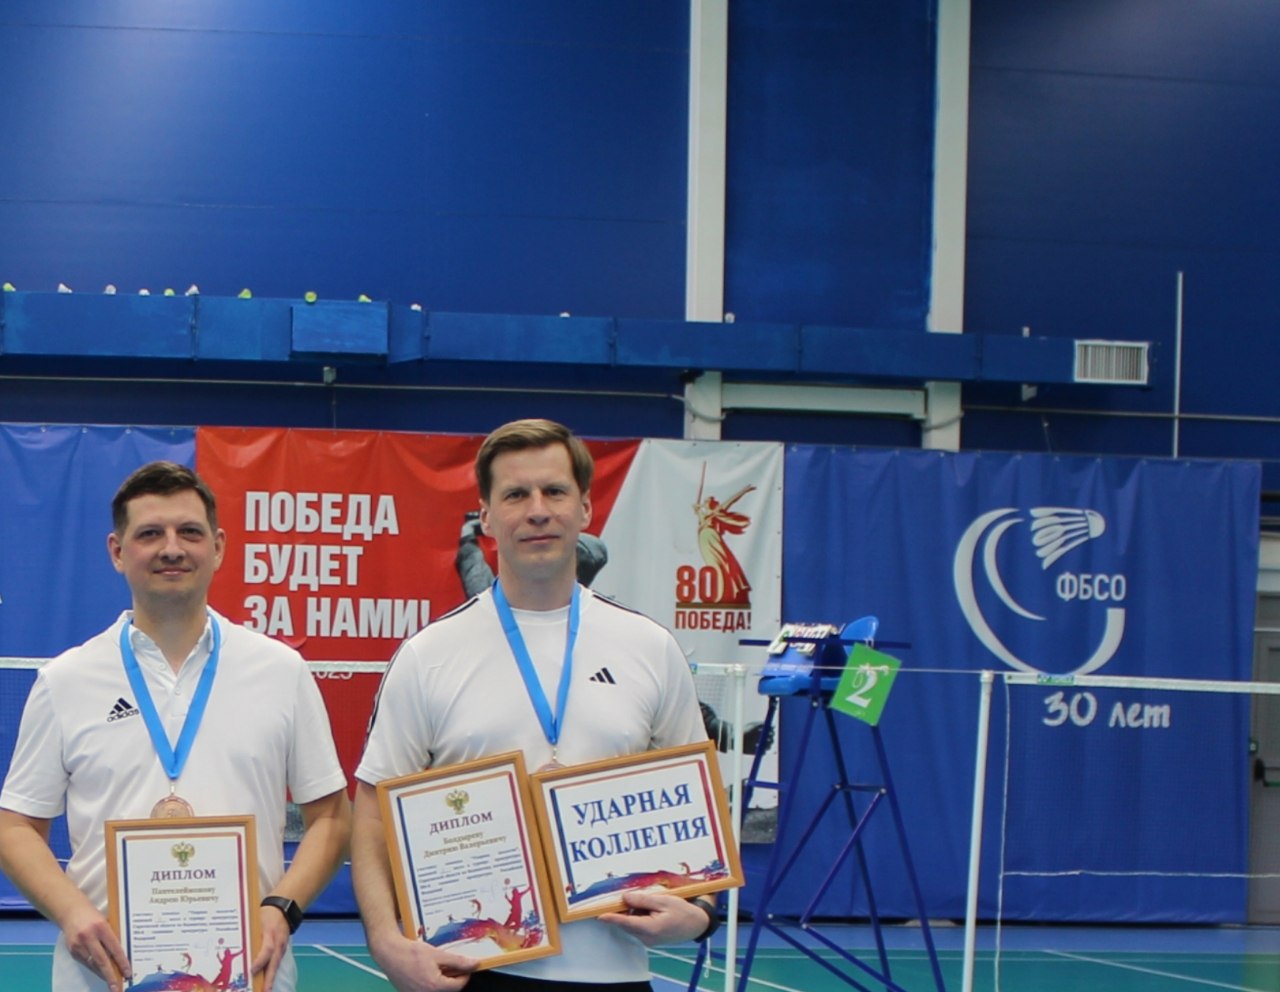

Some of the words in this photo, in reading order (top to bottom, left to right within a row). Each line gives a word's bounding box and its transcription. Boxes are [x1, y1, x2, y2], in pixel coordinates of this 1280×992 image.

[245, 490, 400, 541] ПОБЕДА
[243, 543, 364, 592] БУДЕТ
[675, 564, 719, 604] 80
[1056, 571, 1127, 602] ФБСО
[243, 595, 294, 636] ЗА
[306, 597, 431, 639] НАМИ!
[675, 610, 752, 633] ПОБЕДА!
[845, 663, 880, 708] 2
[1042, 690, 1098, 726] 30
[1108, 702, 1171, 728] лет
[429, 811, 493, 835] ДИПЛОМ
[571, 783, 693, 827] УДАРНАЯ
[569, 816, 710, 863] КОЛЛЕГИЯ
[151, 869, 216, 882] ДИПЛОМ
